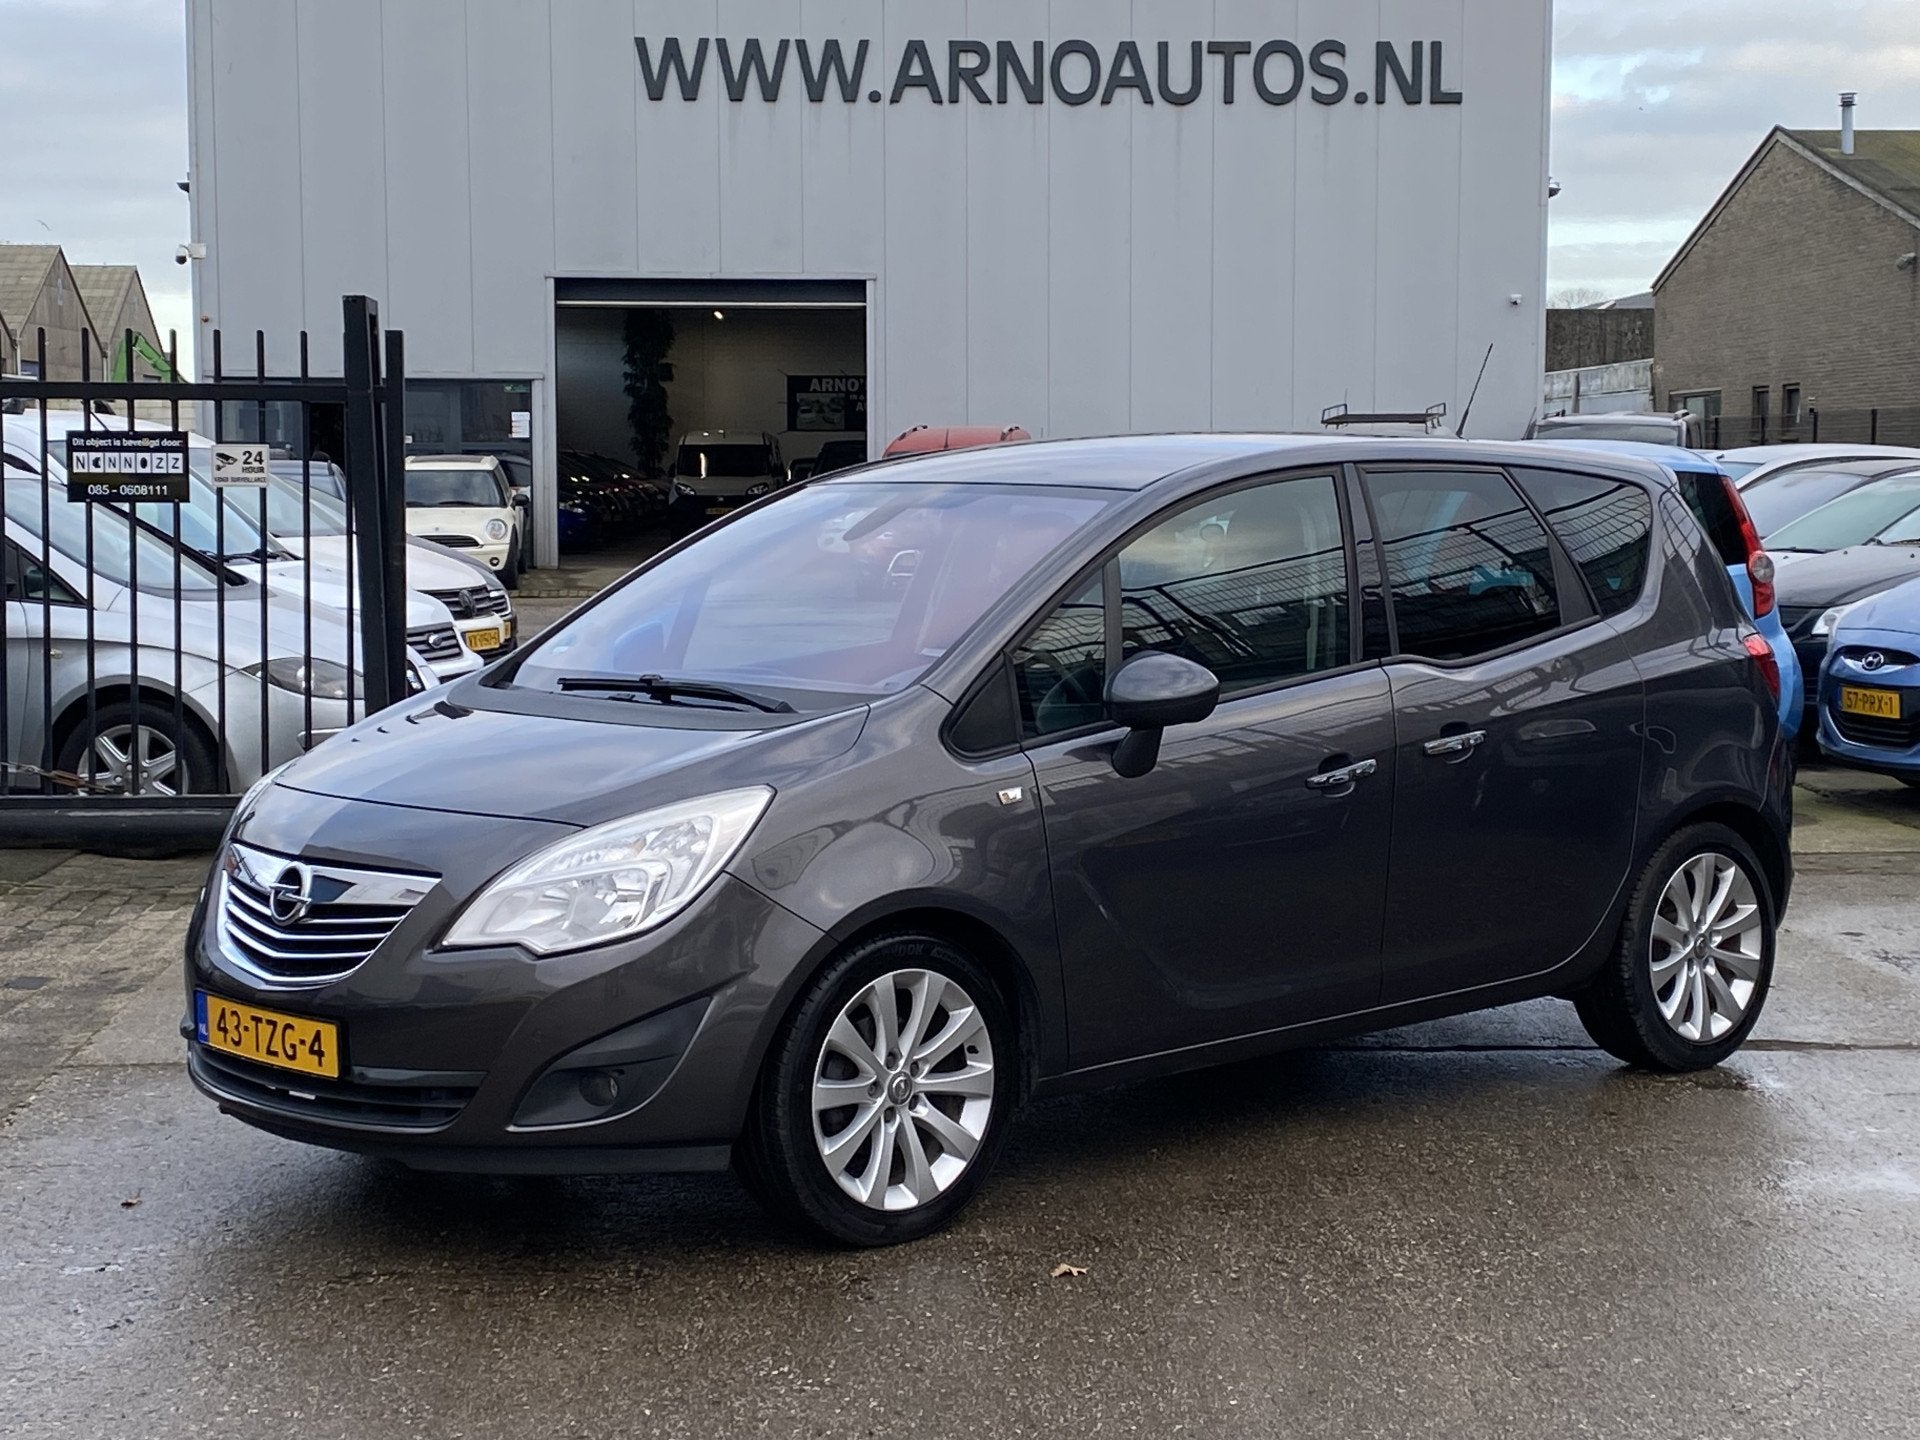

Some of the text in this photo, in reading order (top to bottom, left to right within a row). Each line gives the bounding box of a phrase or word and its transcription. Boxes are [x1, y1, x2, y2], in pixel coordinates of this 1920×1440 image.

[634, 36, 1463, 106] WWW.ARNOAUTOS.NL
[72, 437, 84, 447] Dit
[85, 437, 112, 448] object
[113, 437, 121, 447] is
[122, 437, 160, 448] beveiligd
[242, 450, 264, 465] 24
[241, 466, 265, 474] HOUR
[87, 484, 110, 496] 085
[119, 484, 168, 496] 0608111
[1846, 690, 1894, 715] 57-PRX-1
[216, 1006, 326, 1068] 43-TZG-4
